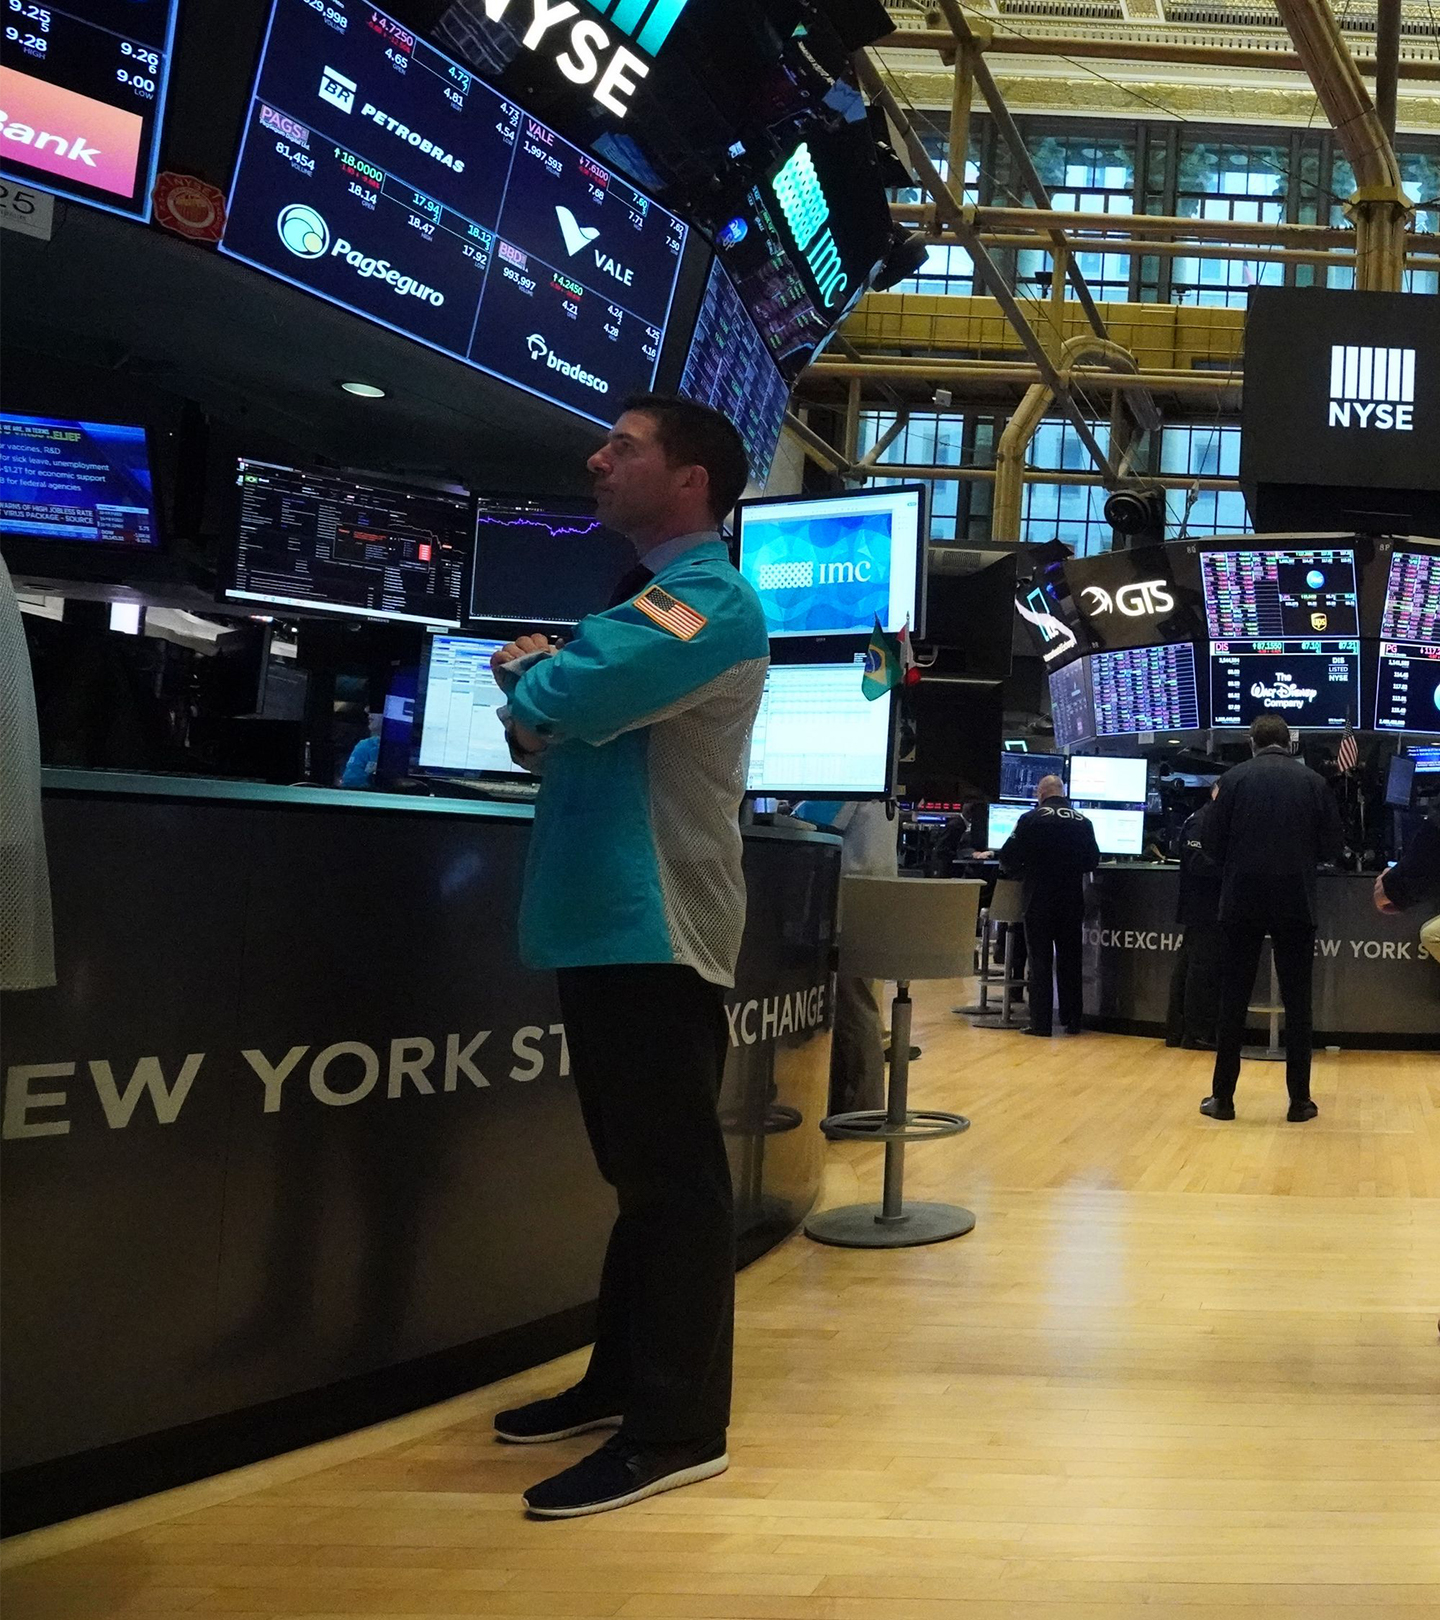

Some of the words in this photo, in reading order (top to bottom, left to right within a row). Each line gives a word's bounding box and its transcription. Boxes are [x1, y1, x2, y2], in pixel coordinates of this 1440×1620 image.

[6, 26, 47, 51] 9.28
[378, 18, 414, 46] 4.7250
[23, 47, 46, 60] HIGH
[121, 42, 158, 65] 9.26
[384, 48, 408, 68] 4.65
[485, 0, 649, 118] YSE
[117, 69, 154, 92] 9.00
[324, 78, 350, 104] BR
[134, 89, 154, 100] LOW
[443, 87, 464, 107] 4.81
[261, 105, 301, 138] PAGS
[496, 123, 515, 140] 4.54
[528, 119, 555, 146] VALE
[361, 103, 465, 173] PETROBRAS
[275, 142, 315, 170] 81,454
[341, 152, 383, 182] 18.0000
[523, 140, 563, 173] 1,997,593
[348, 181, 377, 204] 18.14
[412, 194, 440, 214] 17.94
[408, 215, 435, 235] 18.47
[468, 225, 492, 243] 18.12
[462, 245, 488, 265] 17.92
[331, 237, 445, 307] PagSeguro
[503, 267, 536, 291] 993,997
[594, 250, 634, 286] VALE
[557, 276, 583, 296] 4.2450
[547, 351, 608, 393] bradesco
[1329, 402, 1414, 430] NYSE
[819, 560, 872, 584] imc
[1116, 580, 1174, 617] GTS
[1216, 643, 1229, 651] DIS
[1386, 645, 1397, 653] PG
[1275, 672, 1292, 682] The
[1329, 674, 1348, 682] NYSE
[1264, 699, 1304, 709] Company
[1056, 808, 1084, 821] GTS
[1123, 931, 1184, 951] EXCHA
[1313, 939, 1342, 958] EW
[1349, 940, 1410, 960] YORK
[724, 985, 825, 1048] XCHANGE
[2, 1053, 205, 1140] EW
[241, 1029, 494, 1115] YORK
